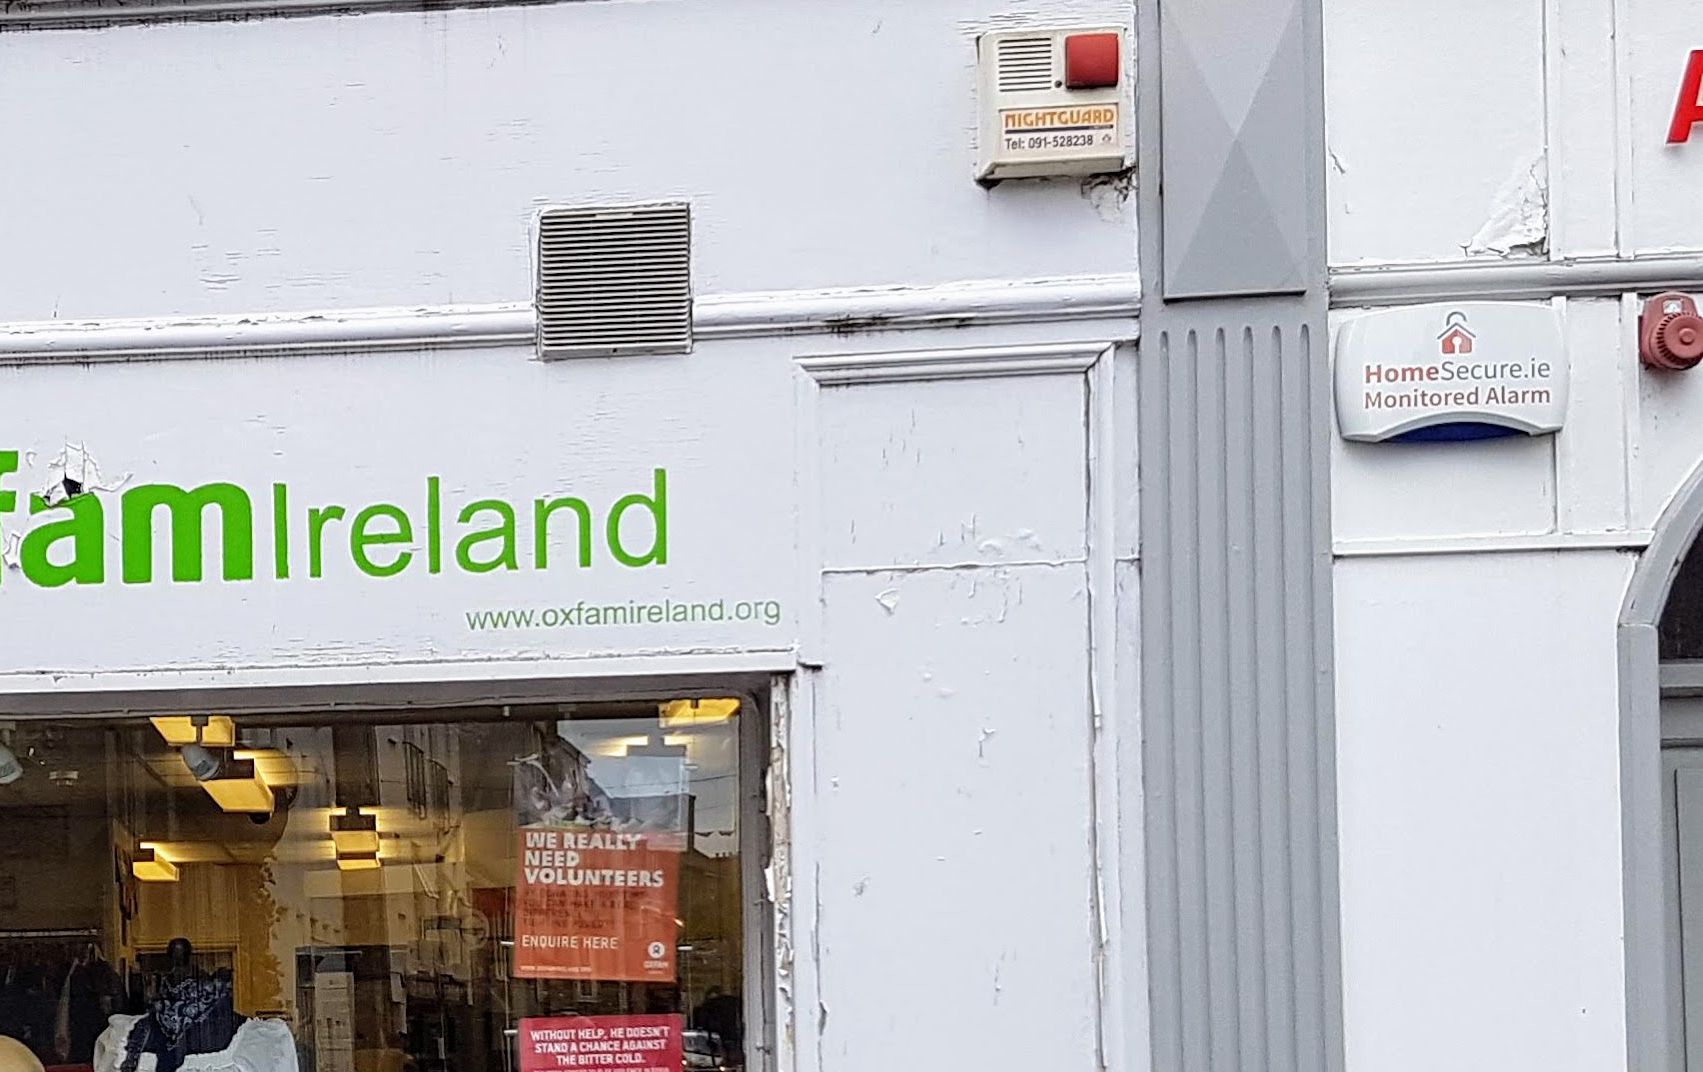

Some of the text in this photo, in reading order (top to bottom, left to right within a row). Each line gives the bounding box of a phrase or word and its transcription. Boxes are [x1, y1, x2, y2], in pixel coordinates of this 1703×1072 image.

[1005, 109, 1114, 127] NIGHTGUARD
[1005, 134, 1094, 150] Tel: 091-528238
[1365, 358, 1551, 384] HomeSecure.ie
[1365, 386, 1551, 410] Monitored Alarm
[465, 598, 782, 631] www.oxfamireland.org
[526, 831, 643, 850] WE REALLY
[524, 850, 580, 867] NEED
[524, 868, 664, 887] VOLUNTEERS
[522, 935, 619, 949] ENQUIRE HERE
[530, 1029, 576, 1041] WITHOUT
[610, 1027, 626, 1039] HE
[626, 1026, 670, 1038] DOESN'T
[534, 1039, 667, 1054] STAND A CHANCE AGAINST
[556, 1055, 577, 1066] THE
[578, 1054, 613, 1065] BITTER
